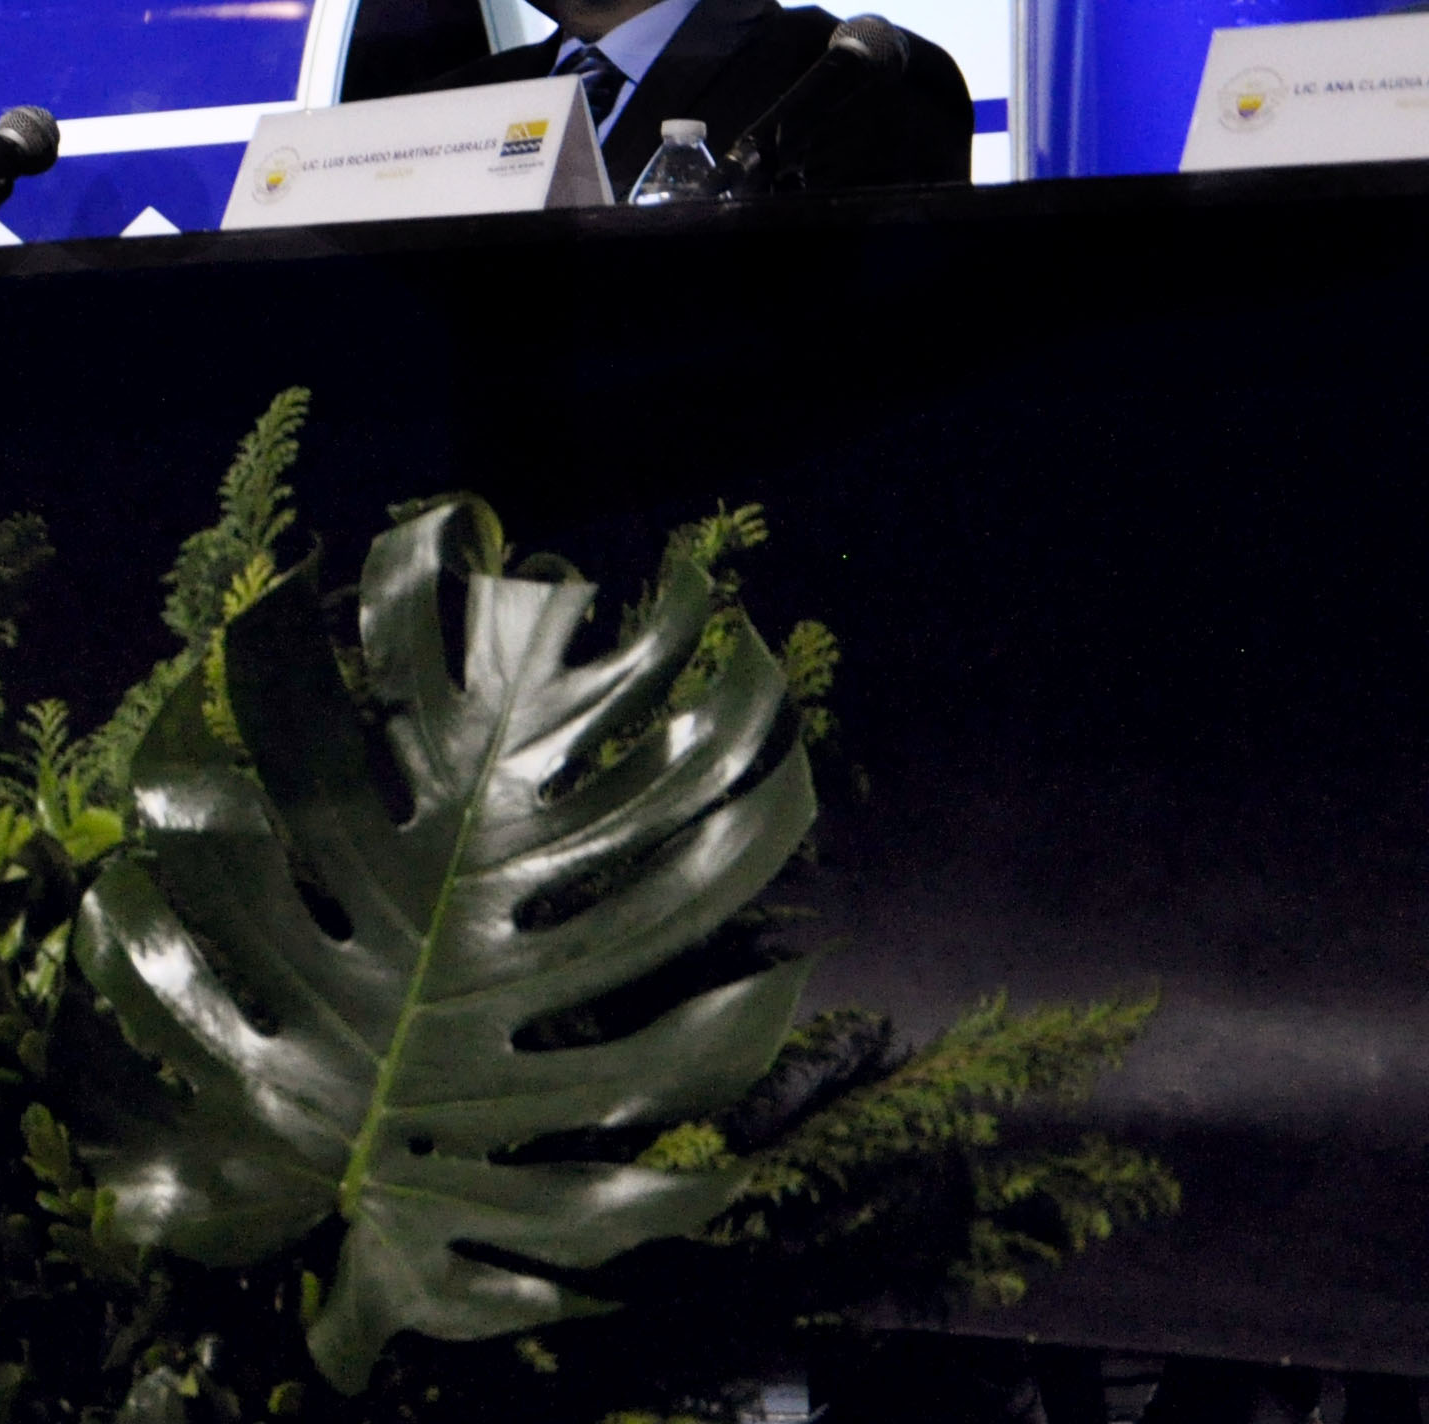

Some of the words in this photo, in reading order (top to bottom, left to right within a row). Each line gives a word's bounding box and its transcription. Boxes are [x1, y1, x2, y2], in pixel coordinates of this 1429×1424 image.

[1325, 80, 1355, 94] ANA
[322, 156, 345, 170] LUIS
[346, 151, 391, 167] RICARDO
[443, 137, 498, 155] CABRALES
